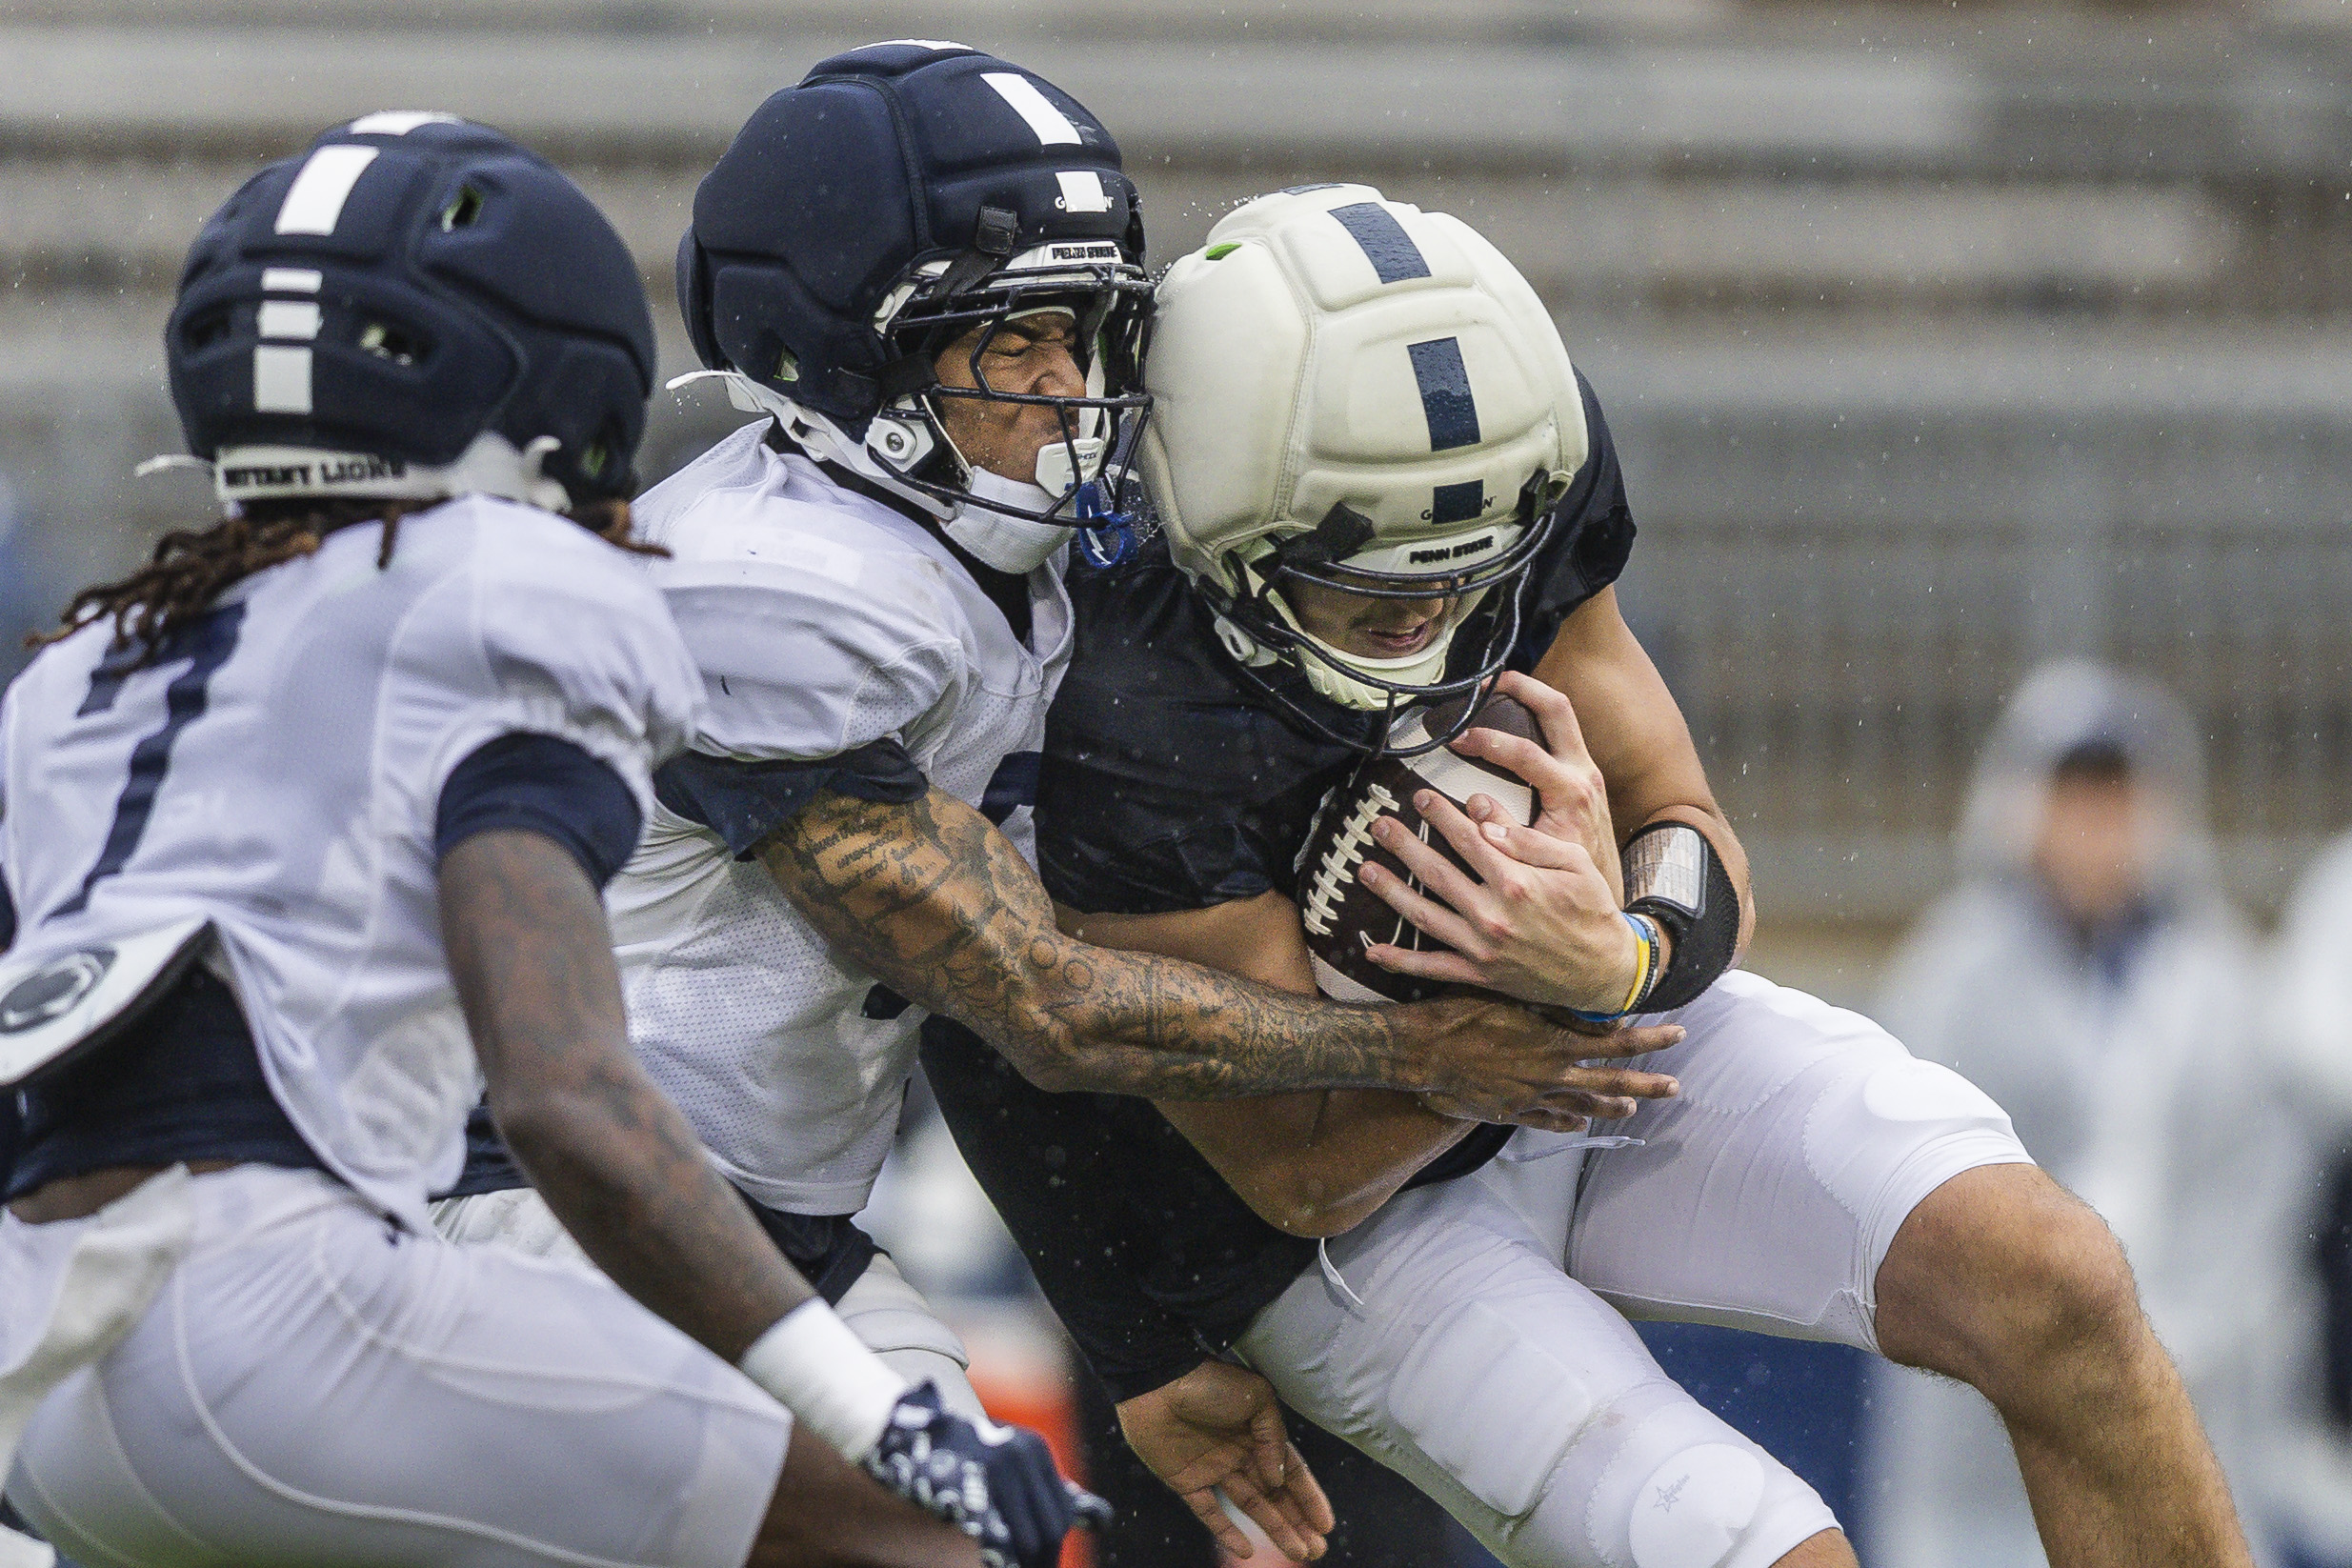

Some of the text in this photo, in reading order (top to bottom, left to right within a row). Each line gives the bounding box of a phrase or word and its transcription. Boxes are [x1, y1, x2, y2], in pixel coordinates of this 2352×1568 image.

[1051, 247, 1086, 260] PENN
[1409, 534, 1495, 564] PENN STATE
